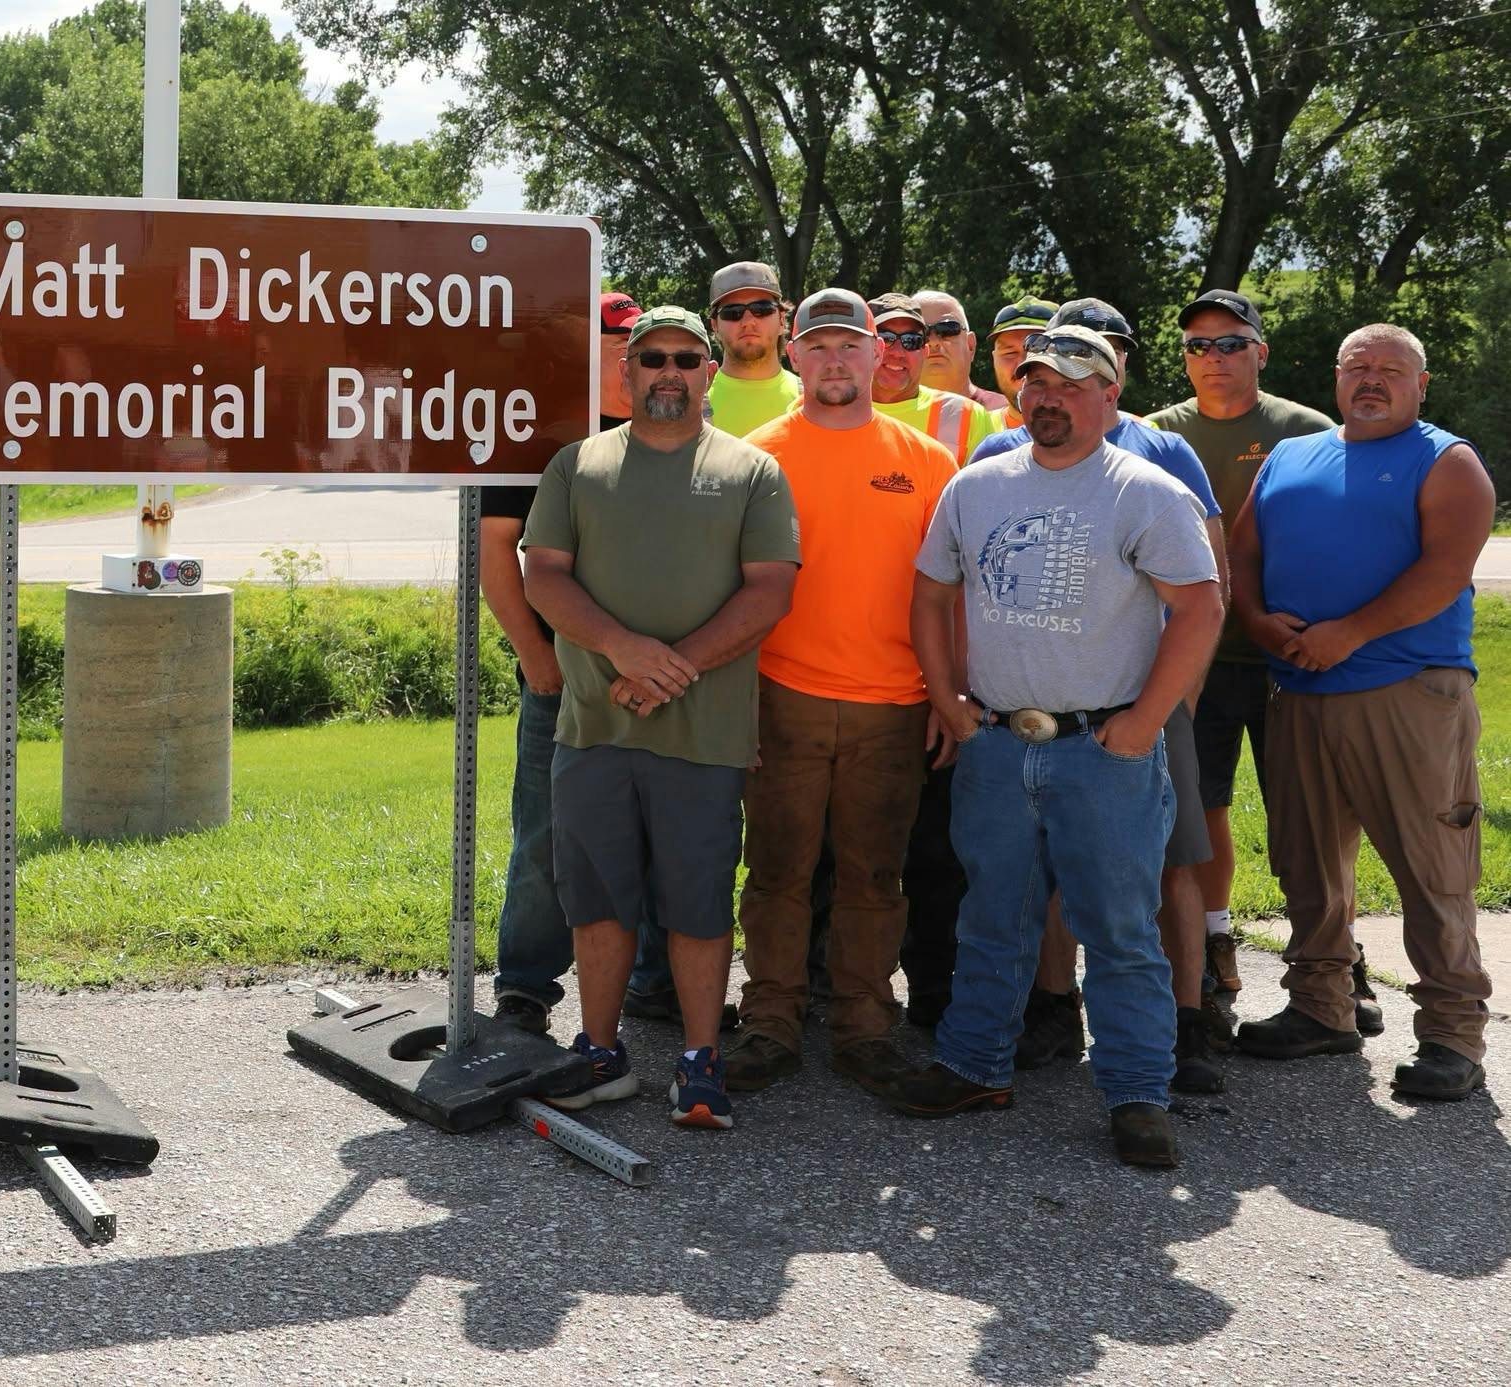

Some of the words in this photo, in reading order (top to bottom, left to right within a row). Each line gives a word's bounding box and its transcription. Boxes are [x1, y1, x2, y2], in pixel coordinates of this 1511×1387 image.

[190, 248, 512, 327] Dickerson
[328, 368, 535, 464] Bridge
[1034, 511, 1078, 611] VIKINGS
[1066, 530, 1090, 605] FOOTBALL
[1005, 610, 1082, 635] EXCUSES
[461, 1051, 507, 1070] NEOLA
